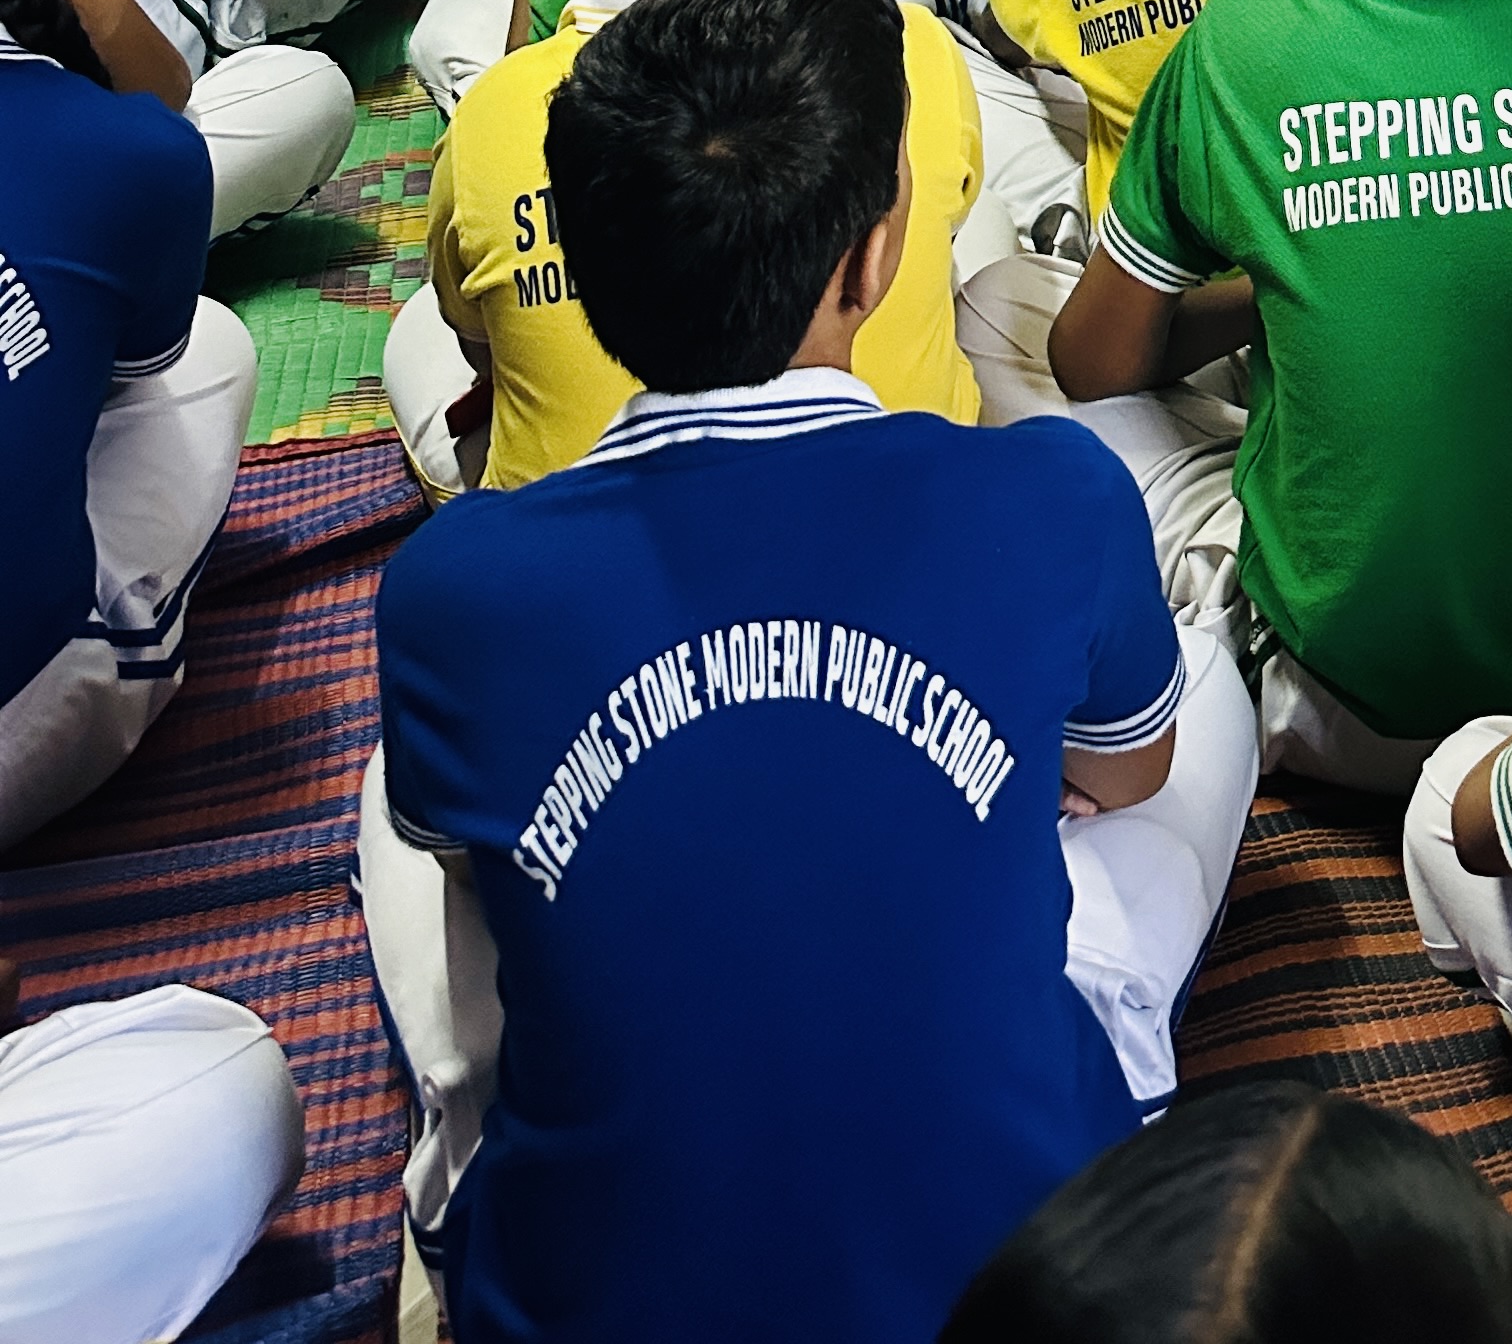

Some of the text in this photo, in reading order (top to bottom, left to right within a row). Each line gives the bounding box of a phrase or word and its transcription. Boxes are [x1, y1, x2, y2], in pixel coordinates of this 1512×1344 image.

[1078, 4, 1144, 57] MODERN
[1279, 93, 1484, 172] STEPPING
[1283, 174, 1400, 233] MODERN
[513, 619, 1017, 902] STEPPING STONE MODERN PUBLIC SCHOOL
